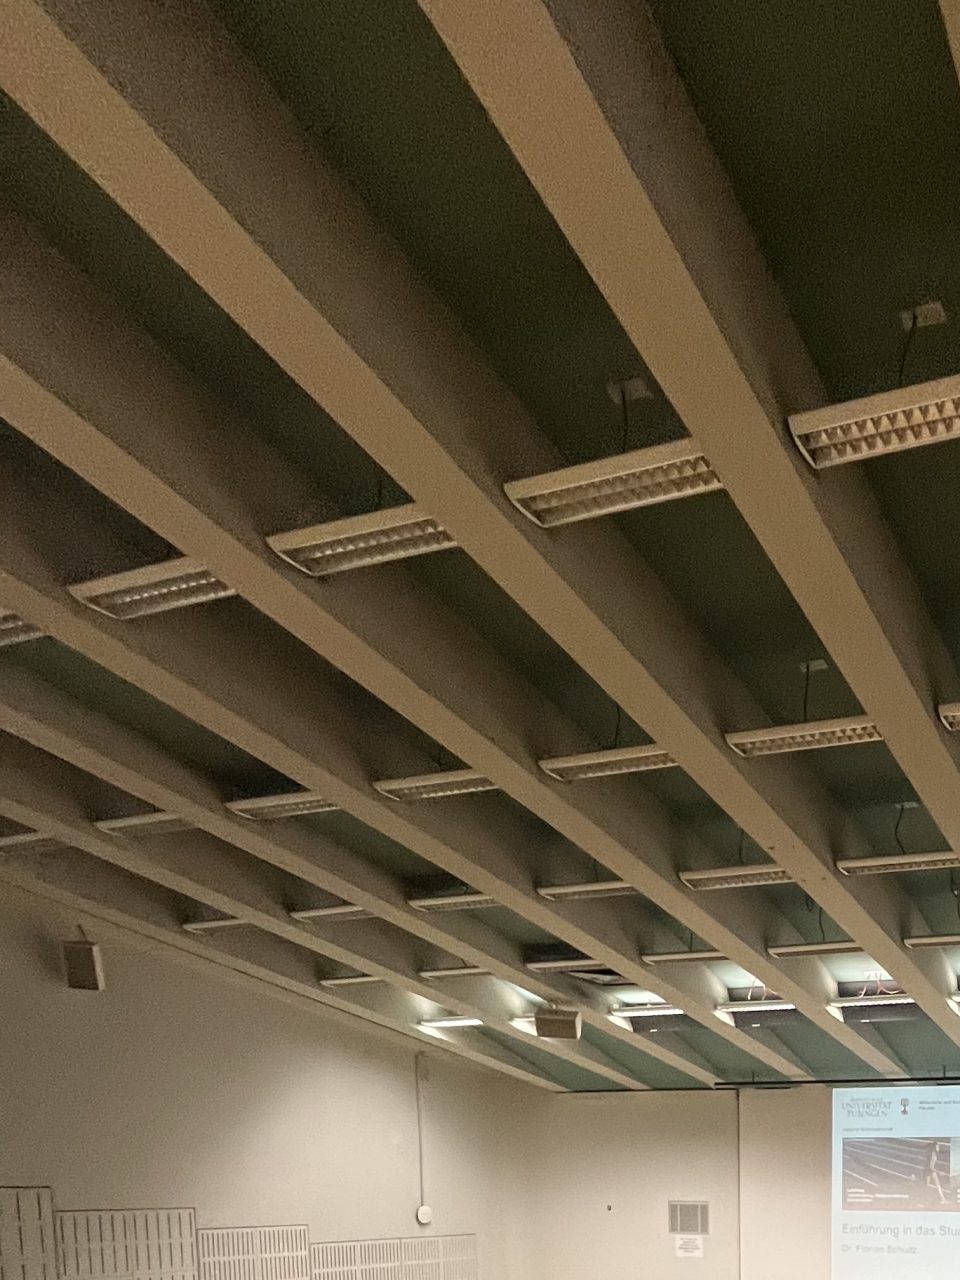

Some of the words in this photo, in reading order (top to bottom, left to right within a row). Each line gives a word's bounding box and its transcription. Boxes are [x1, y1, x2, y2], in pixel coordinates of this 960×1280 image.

[841, 1223, 900, 1239] Einführung
[903, 1224, 912, 1236] in
[915, 1225, 936, 1237] das
